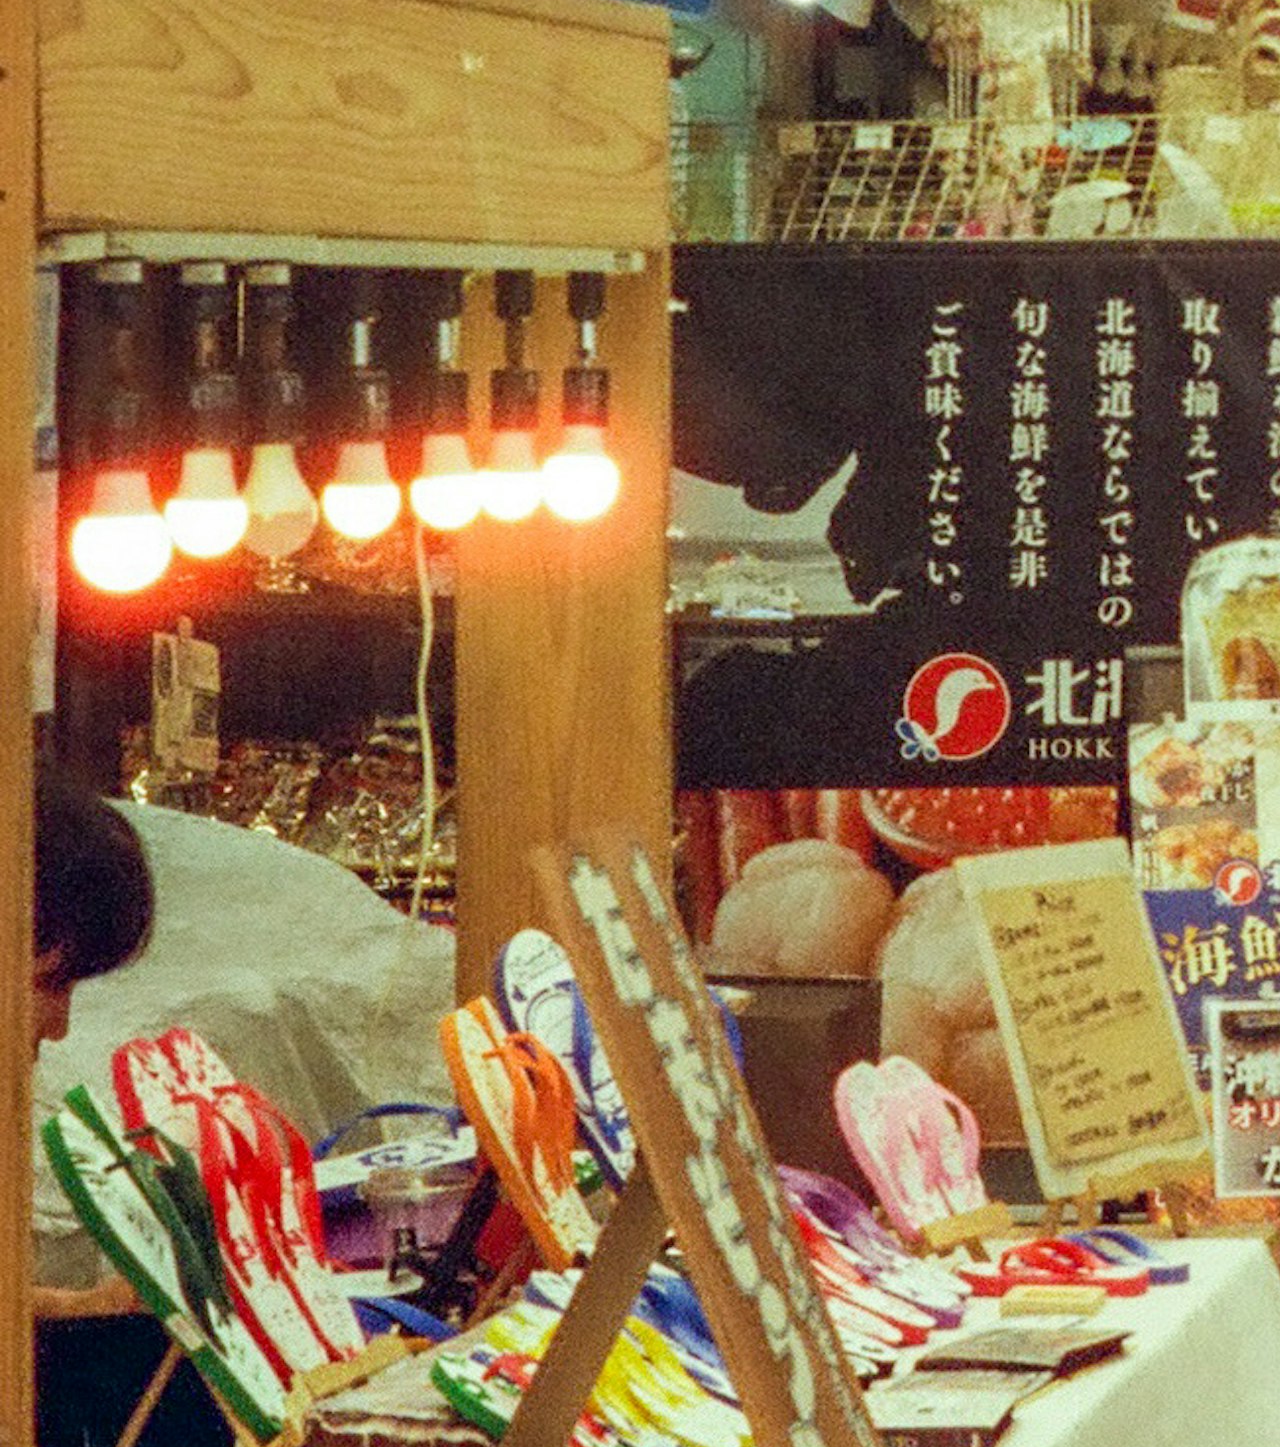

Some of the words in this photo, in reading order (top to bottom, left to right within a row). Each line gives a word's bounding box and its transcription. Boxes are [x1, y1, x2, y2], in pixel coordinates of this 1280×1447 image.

[924, 300, 965, 606] ご賞味ください。
[1009, 297, 1051, 590] 旬な海鮮を是非
[1097, 296, 1136, 627] 北海道ならではの
